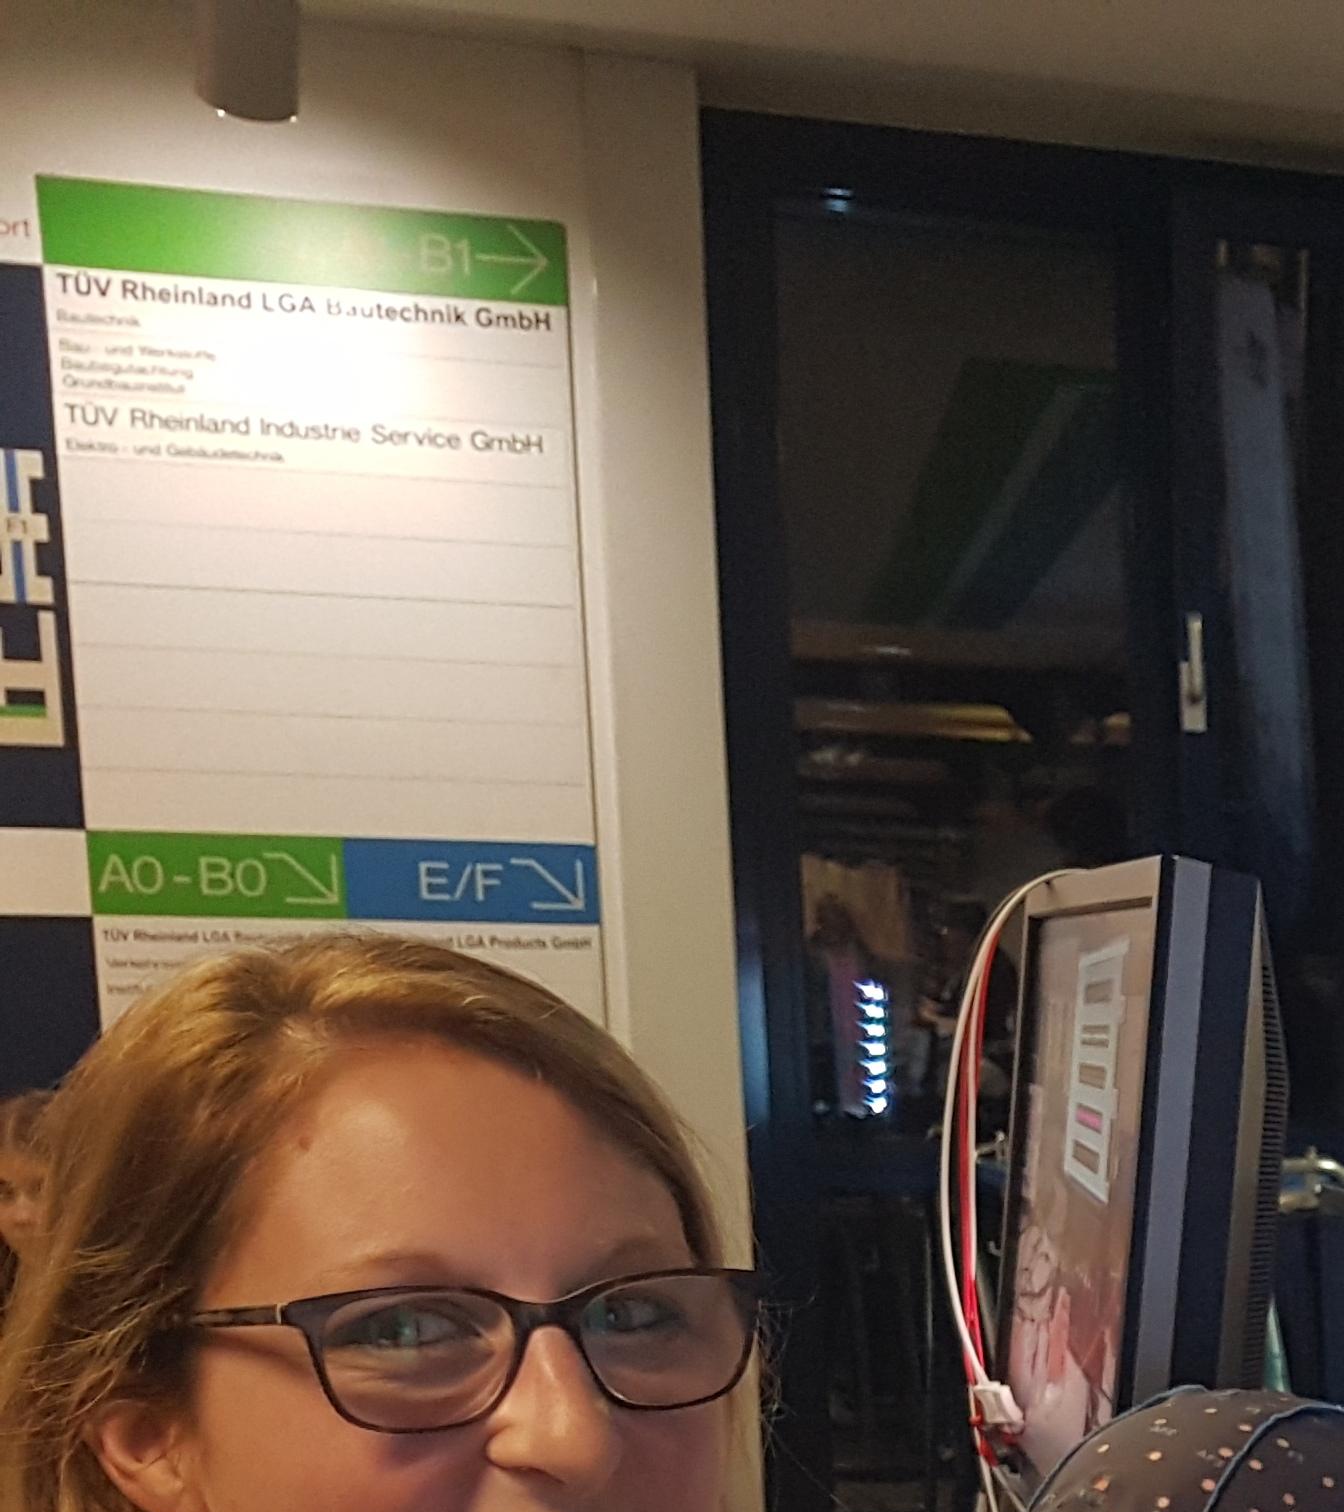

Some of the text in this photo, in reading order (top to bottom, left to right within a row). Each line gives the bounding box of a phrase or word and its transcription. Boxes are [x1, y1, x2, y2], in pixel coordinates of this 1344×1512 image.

[419, 232, 471, 277] B1
[56, 271, 112, 297] TÜV
[121, 278, 252, 311] Rheinland
[262, 293, 315, 313] LGA
[475, 307, 552, 331] GmbH
[64, 401, 544, 453] TÜV Rheinland Industrie Service GmbH
[418, 861, 503, 902] E/F
